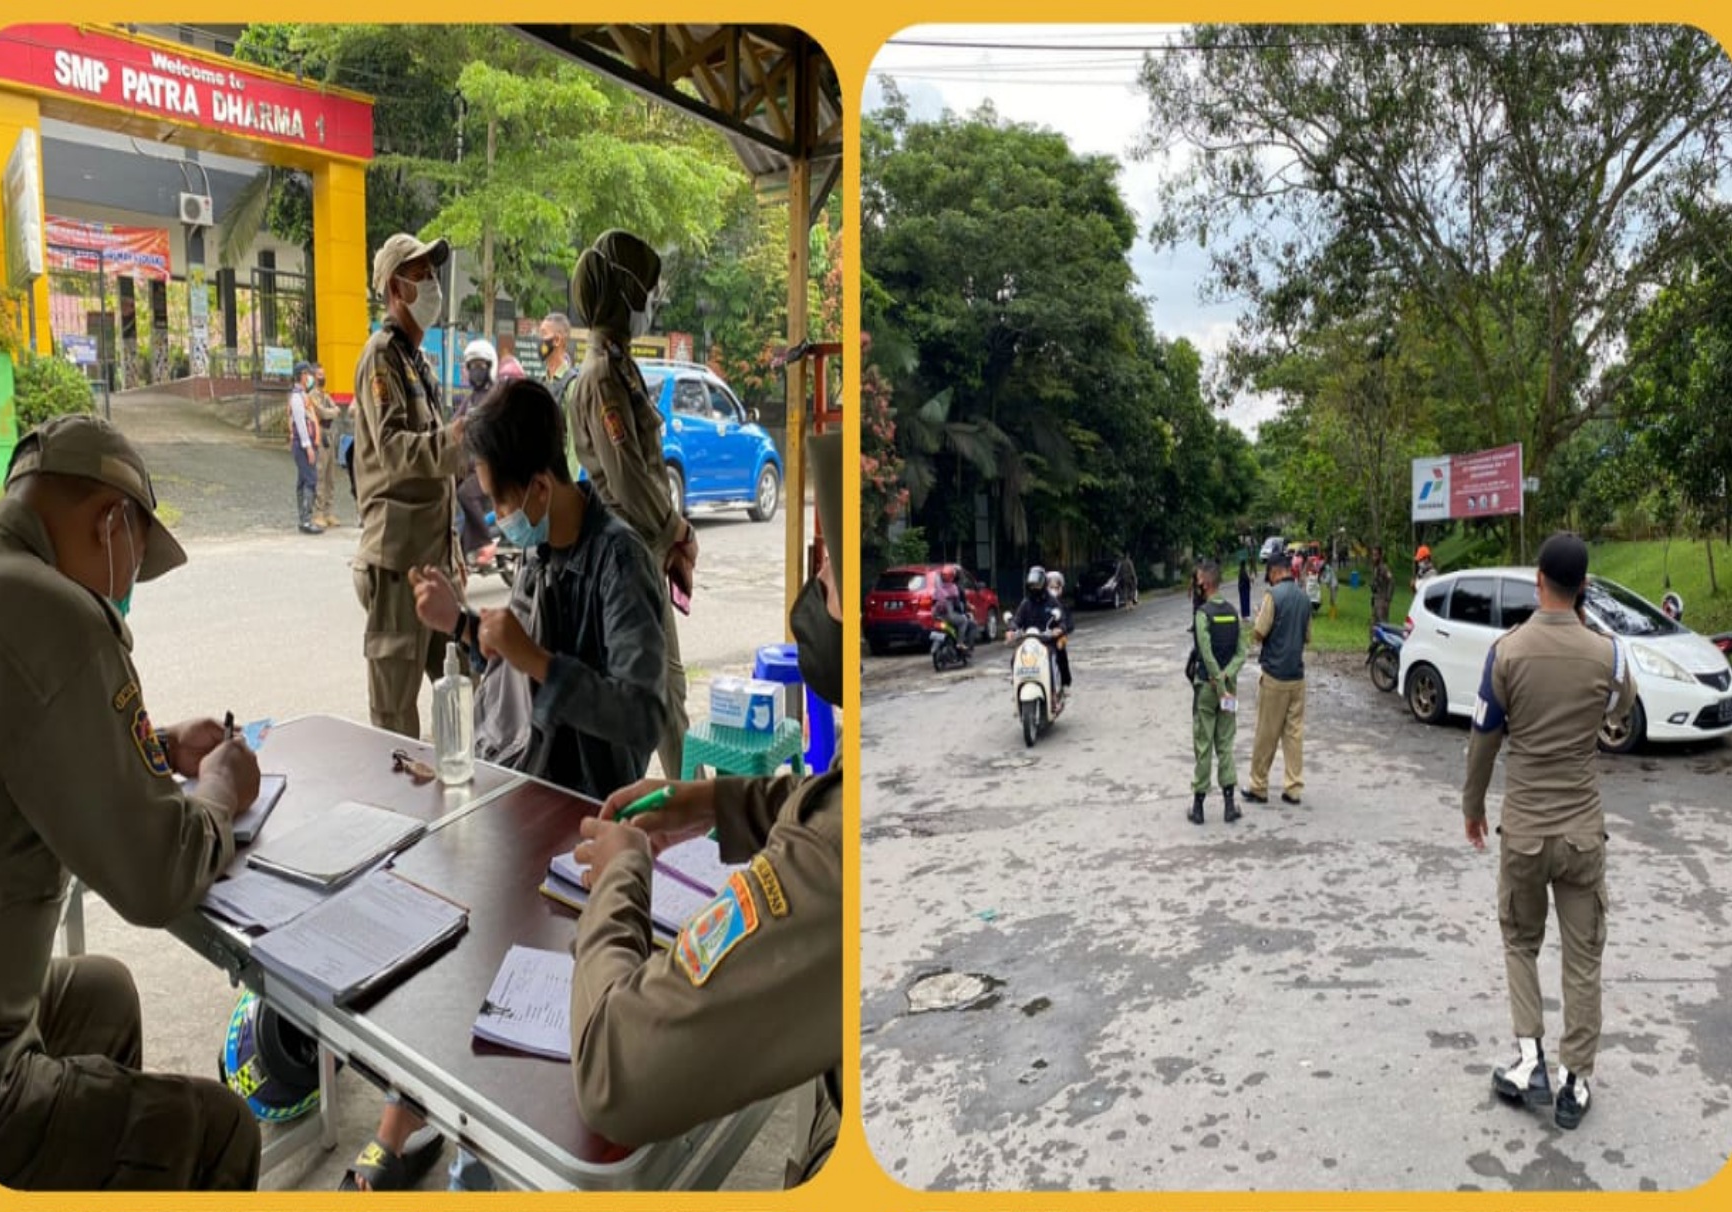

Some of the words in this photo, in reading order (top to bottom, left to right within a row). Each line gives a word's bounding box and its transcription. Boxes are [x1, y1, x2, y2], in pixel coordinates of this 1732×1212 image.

[54, 49, 110, 94] SMP
[122, 67, 200, 116] PATRA
[212, 89, 305, 138] DHARMA
[315, 114, 326, 142] 1
[150, 51, 225, 86] Welcome
[230, 75, 245, 91] to
